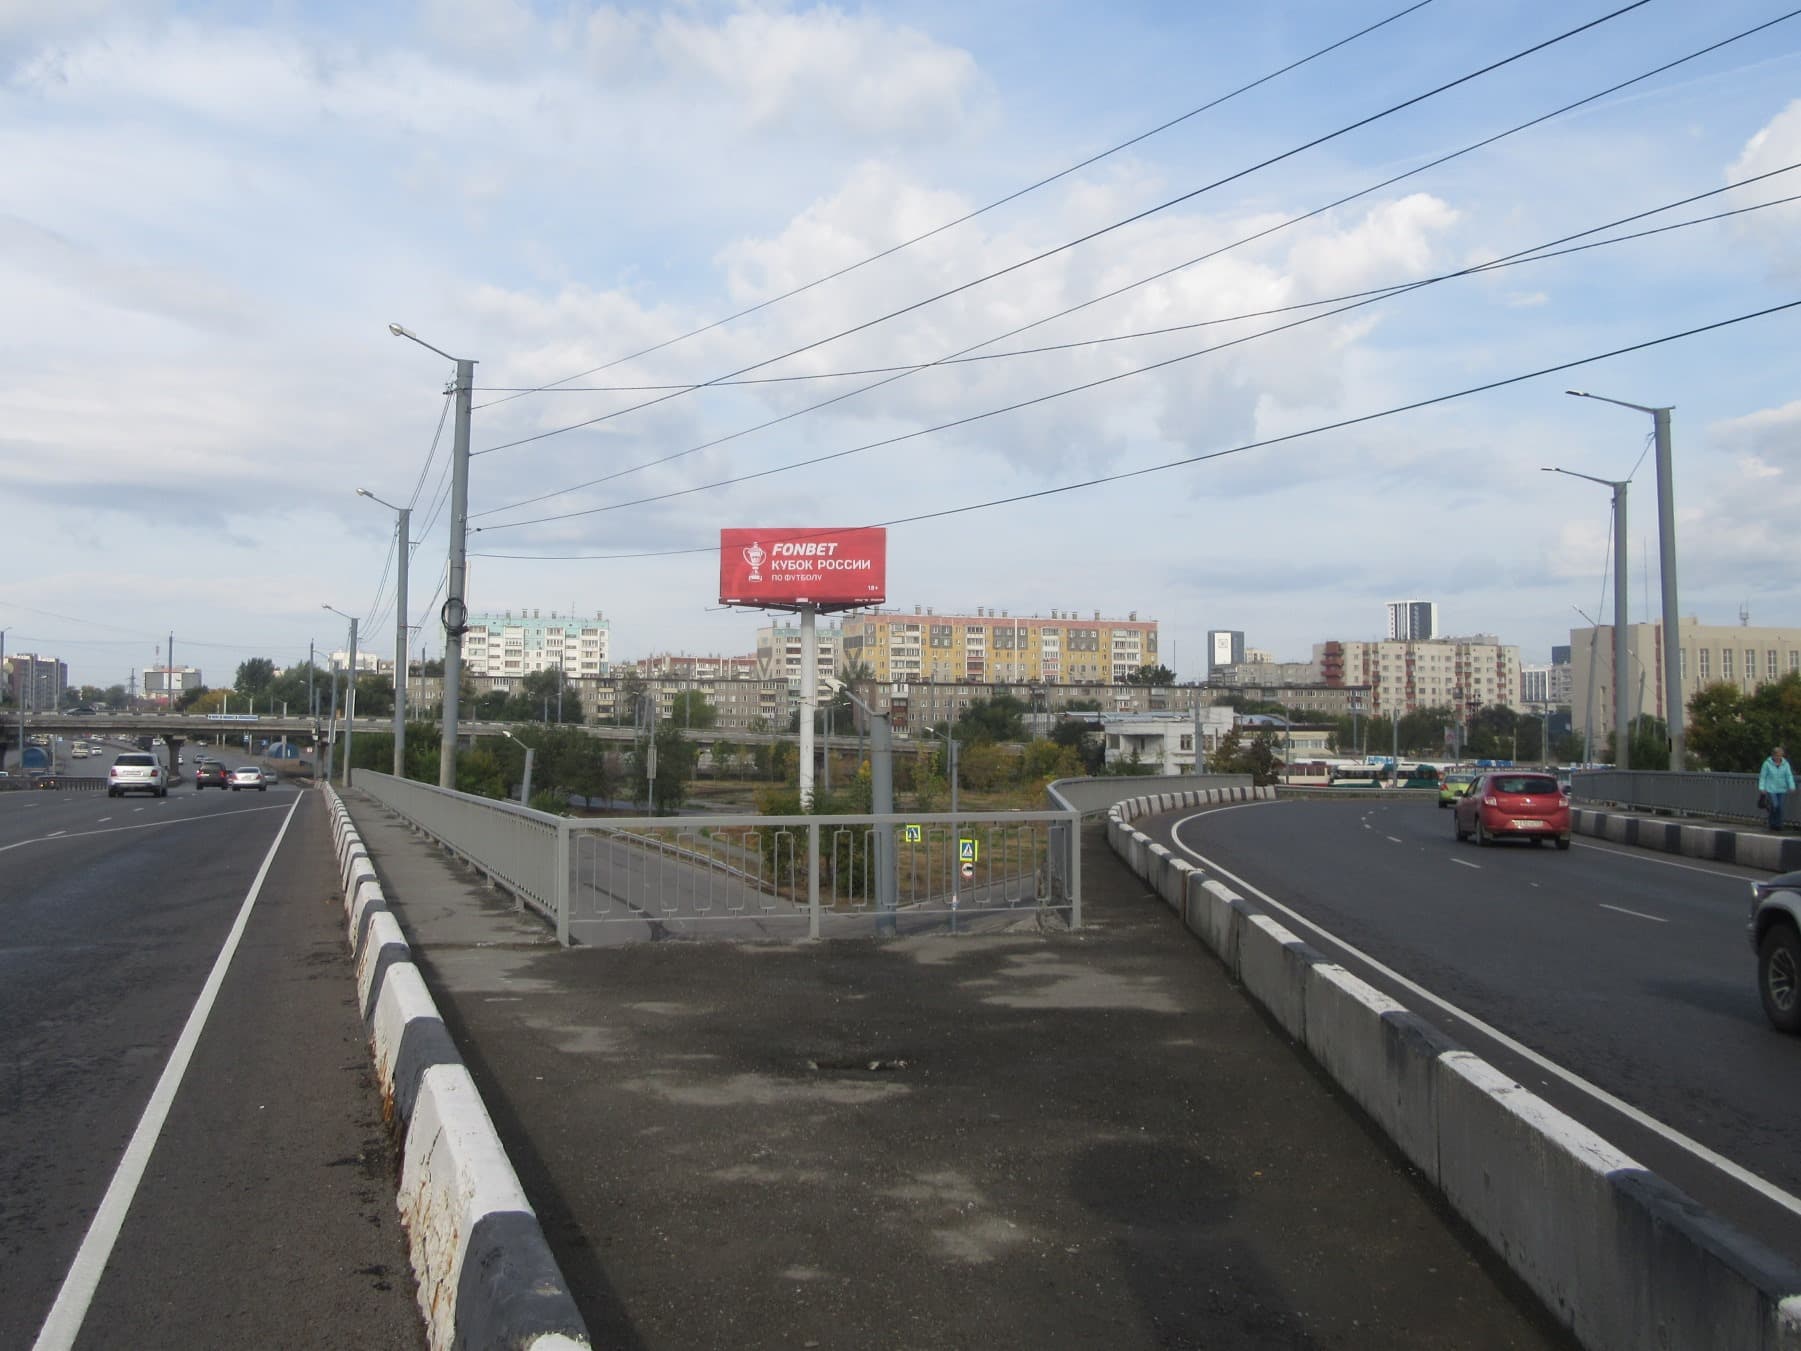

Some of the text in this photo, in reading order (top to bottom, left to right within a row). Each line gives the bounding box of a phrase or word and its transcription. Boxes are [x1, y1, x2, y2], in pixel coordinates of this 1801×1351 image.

[772, 542, 838, 556] FONBET
[771, 559, 871, 570] КУБОК РОССИИ
[771, 574, 822, 582] ПО ФУТБОЛУ
